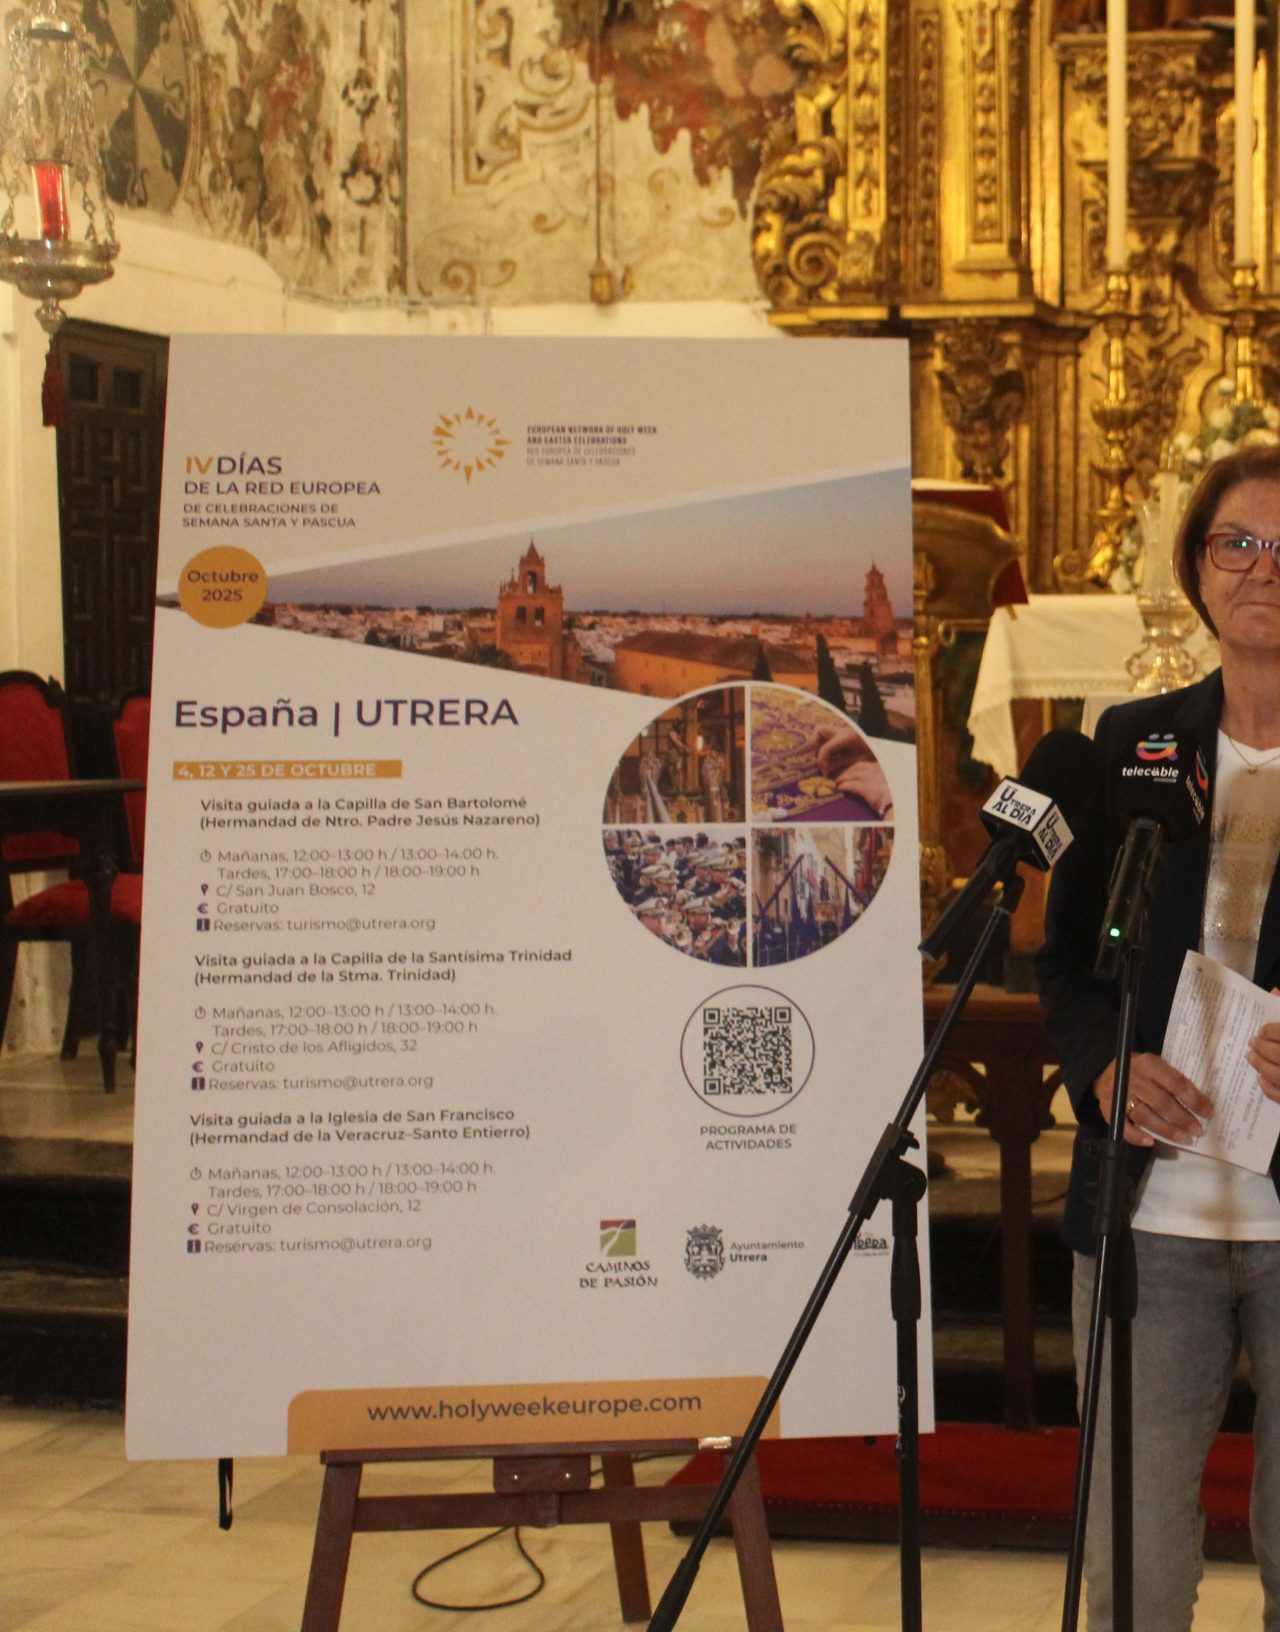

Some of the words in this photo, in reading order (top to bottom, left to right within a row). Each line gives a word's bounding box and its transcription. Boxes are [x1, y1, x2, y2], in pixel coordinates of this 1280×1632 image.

[216, 452, 283, 475] DÍAS
[184, 480, 209, 494] DE
[216, 481, 239, 494] LA
[245, 480, 283, 495] RED
[290, 481, 380, 495] EUROPEA
[183, 502, 201, 514] DE
[205, 502, 316, 514] CELEBRACIONES
[320, 503, 338, 514] DE
[182, 516, 239, 528] SEMANA
[242, 516, 286, 527] SANTA
[290, 517, 298, 527] Y
[302, 517, 355, 528] PASCUA
[187, 570, 258, 584] Octubre
[201, 588, 242, 602] 2025
[175, 698, 317, 734] España
[356, 699, 518, 726] UTRERA
[199, 766, 215, 777] 12
[220, 766, 231, 777] Y
[236, 765, 256, 777] 25
[262, 765, 285, 777] DE
[291, 764, 376, 777] OCTUBRE
[200, 798, 242, 811] Visita
[247, 798, 300, 815] guiada
[304, 801, 312, 810] a
[317, 798, 330, 810] la
[334, 797, 386, 814] Capilla
[390, 797, 410, 810] de
[414, 797, 442, 810] San
[445, 796, 526, 809] Bartolomé
[200, 815, 296, 831] (Hermandad
[301, 815, 320, 827] de
[325, 815, 362, 827] Ntro.
[367, 814, 412, 827] Padre
[416, 814, 458, 826] Jesús
[463, 813, 539, 827] Nazareno)
[235, 883, 264, 898] San
[267, 883, 304, 897] Juan
[361, 882, 375, 895] 12
[216, 901, 279, 915] Gratuito
[286, 916, 435, 933] turismo@utrera.org
[194, 953, 237, 967] Visita
[241, 952, 295, 969] guiada
[300, 955, 308, 965] a
[313, 952, 326, 965] la
[330, 951, 383, 967] Capilla
[387, 951, 407, 964] de
[411, 951, 424, 964] la
[428, 949, 504, 963] Santísima
[508, 948, 571, 962] Trinidad
[194, 970, 292, 987] (Hermandad
[296, 970, 316, 983] de
[321, 970, 334, 982] la
[338, 969, 382, 982] Stma.
[386, 968, 455, 982] Trinidad)
[230, 1040, 276, 1055] Cristo
[278, 1040, 299, 1054] de
[302, 1040, 324, 1053] los
[400, 1038, 417, 1052] 32
[211, 1059, 275, 1073] Gratuito
[282, 1075, 433, 1091] turismo@utrera.org
[189, 1113, 232, 1127] Visita
[237, 1112, 291, 1129] guiada
[296, 1114, 305, 1124] a
[310, 1111, 322, 1124] la
[328, 1110, 378, 1127] Iglesia
[382, 1109, 402, 1122] de
[406, 1109, 435, 1122] San
[440, 1107, 514, 1121] Francisco
[190, 1129, 288, 1147] (Hermandad
[293, 1129, 313, 1142] de
[318, 1129, 330, 1142] la
[462, 1125, 530, 1140] Entierro)
[700, 1124, 776, 1136] PROGRAMA
[778, 1123, 796, 1134] DE
[705, 1137, 792, 1150] ACTIVIDADES
[227, 1202, 278, 1219] Virgen
[282, 1201, 302, 1215] de
[406, 1198, 420, 1212] 12
[207, 1220, 271, 1235] Gratuito
[279, 1236, 432, 1253] turismo@utrera.org
[729, 1240, 804, 1252] Ayuntamiento
[729, 1251, 767, 1262] Utrera
[585, 1260, 650, 1273] CAMINOS
[366, 1396, 701, 1423] www.holyweekeurope.com
